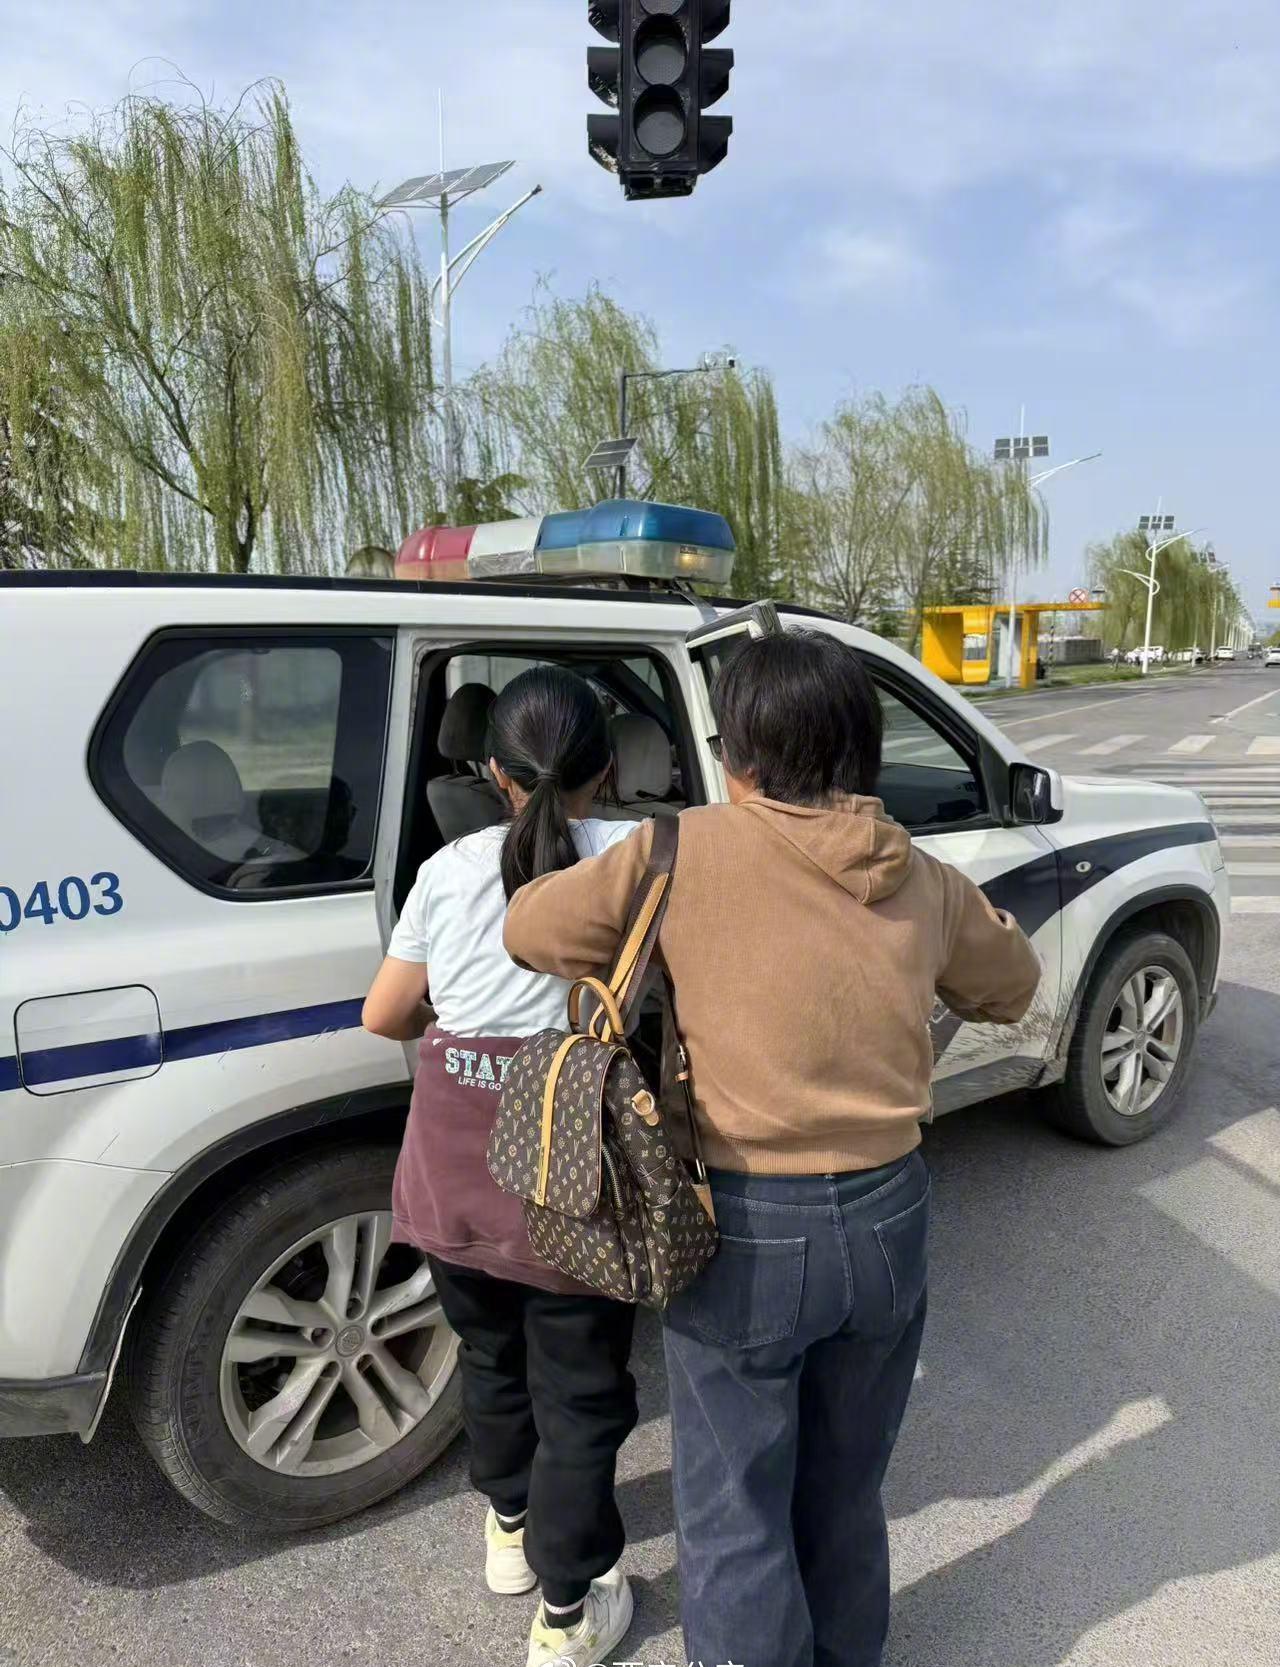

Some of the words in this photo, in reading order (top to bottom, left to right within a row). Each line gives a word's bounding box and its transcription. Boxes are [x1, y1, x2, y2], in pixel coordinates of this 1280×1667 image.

[0, 871, 123, 931] 0403
[458, 1076, 476, 1087] LIFE
[477, 1080, 486, 1088] IS
